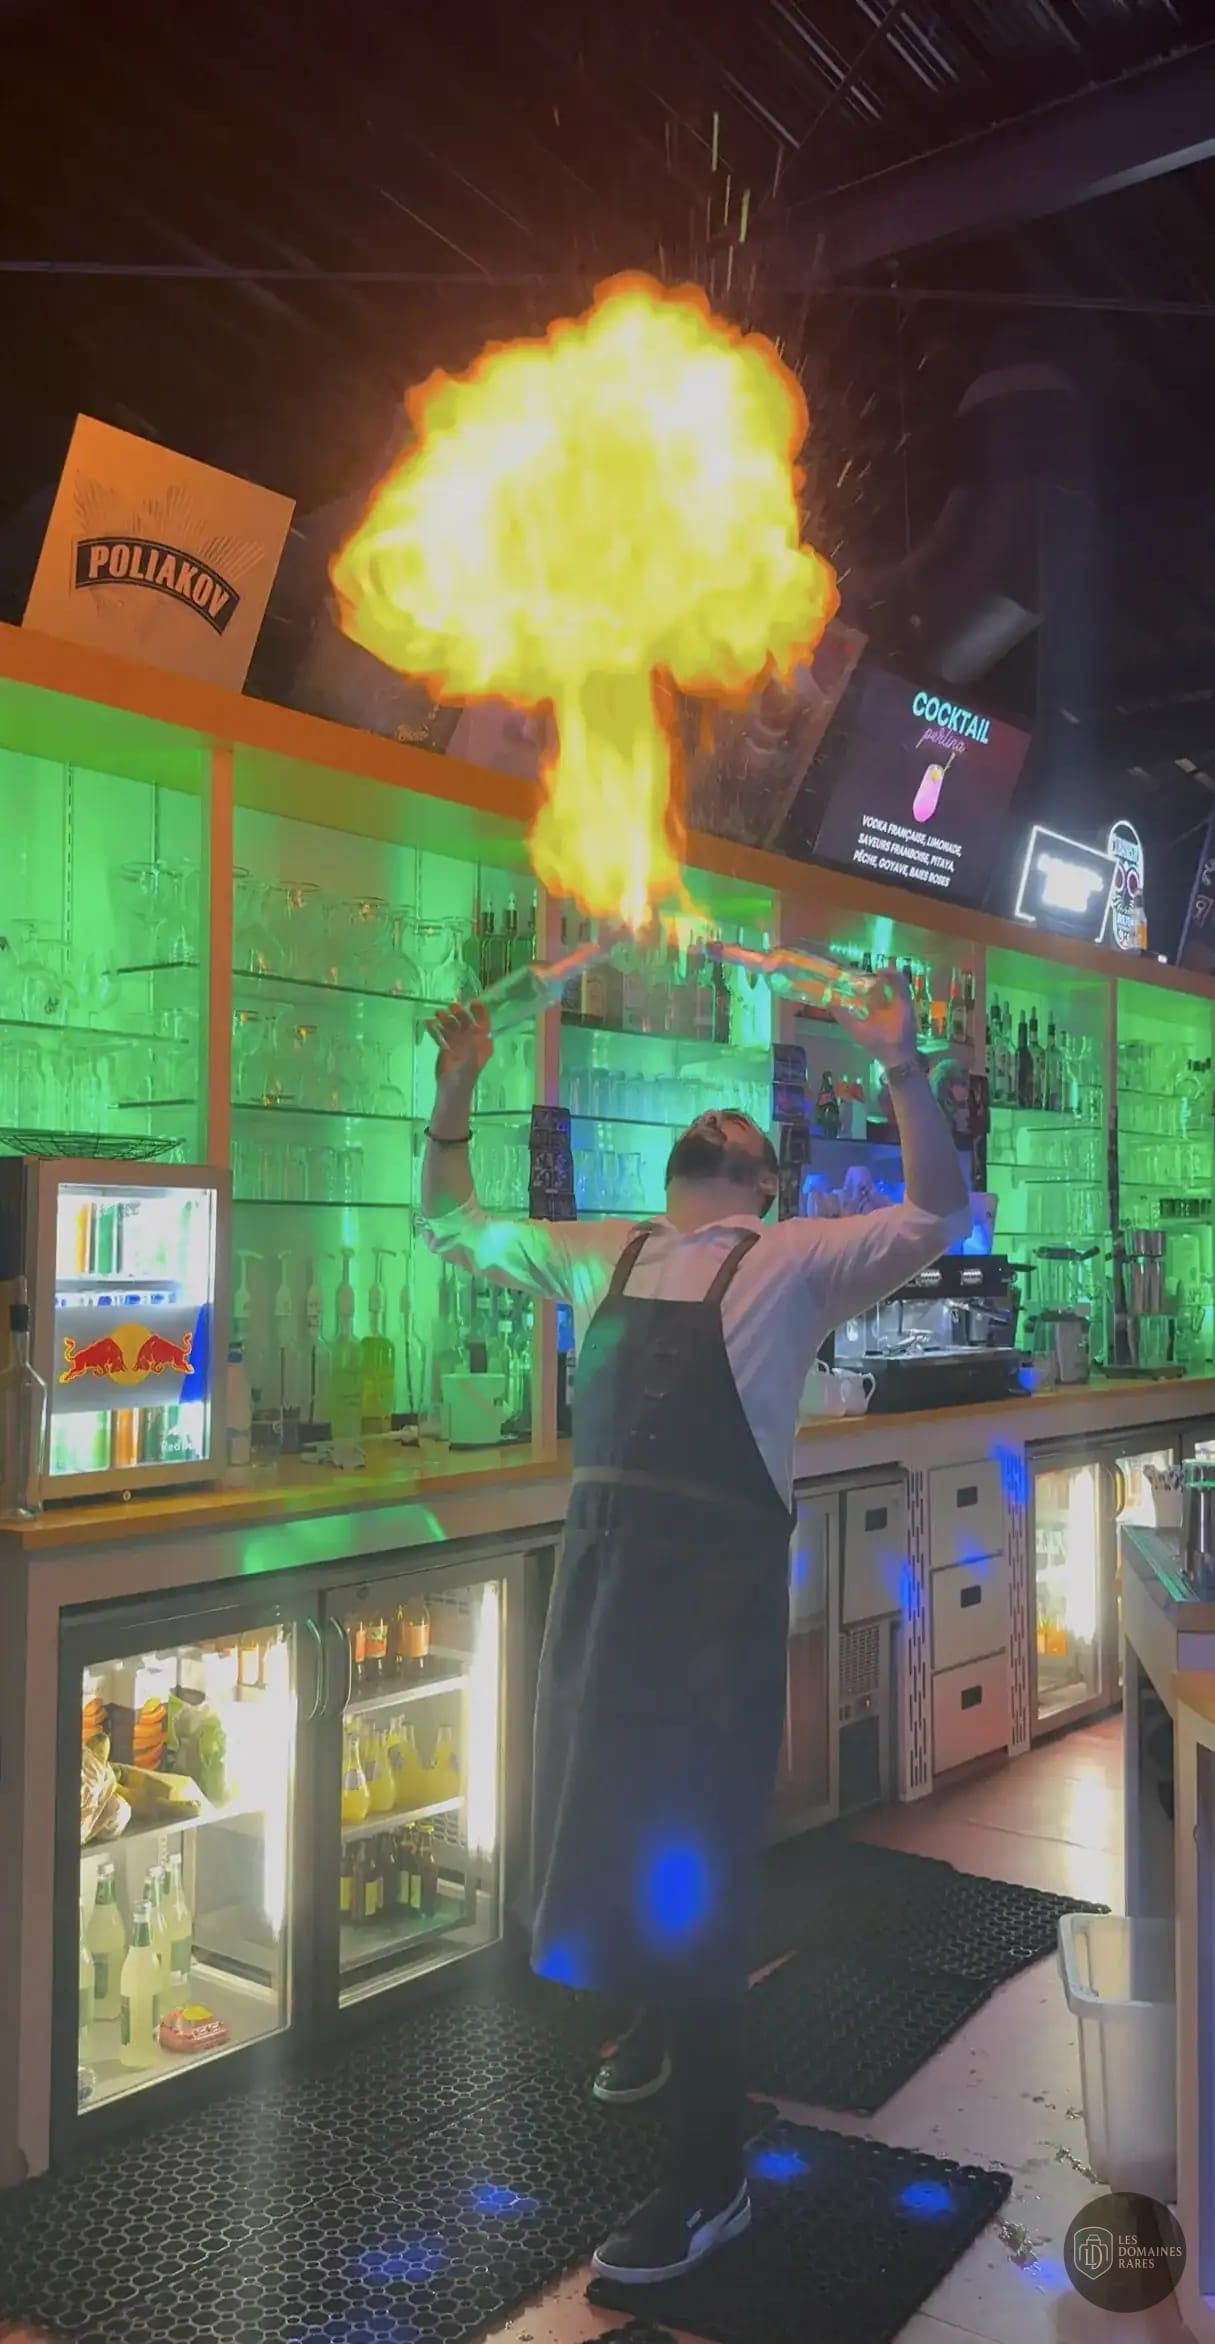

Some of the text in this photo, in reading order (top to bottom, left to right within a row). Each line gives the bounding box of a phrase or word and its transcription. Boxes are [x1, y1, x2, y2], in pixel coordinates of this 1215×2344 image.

[88, 544, 230, 619] POLIAKOV
[912, 691, 990, 745] COCKTAIL
[862, 814, 888, 833] VODKA
[858, 832, 955, 873] SAVEURS FRAMBOISE, PITAYA,
[878, 858, 909, 878] GOYAVE,
[908, 866, 930, 882] BAIES
